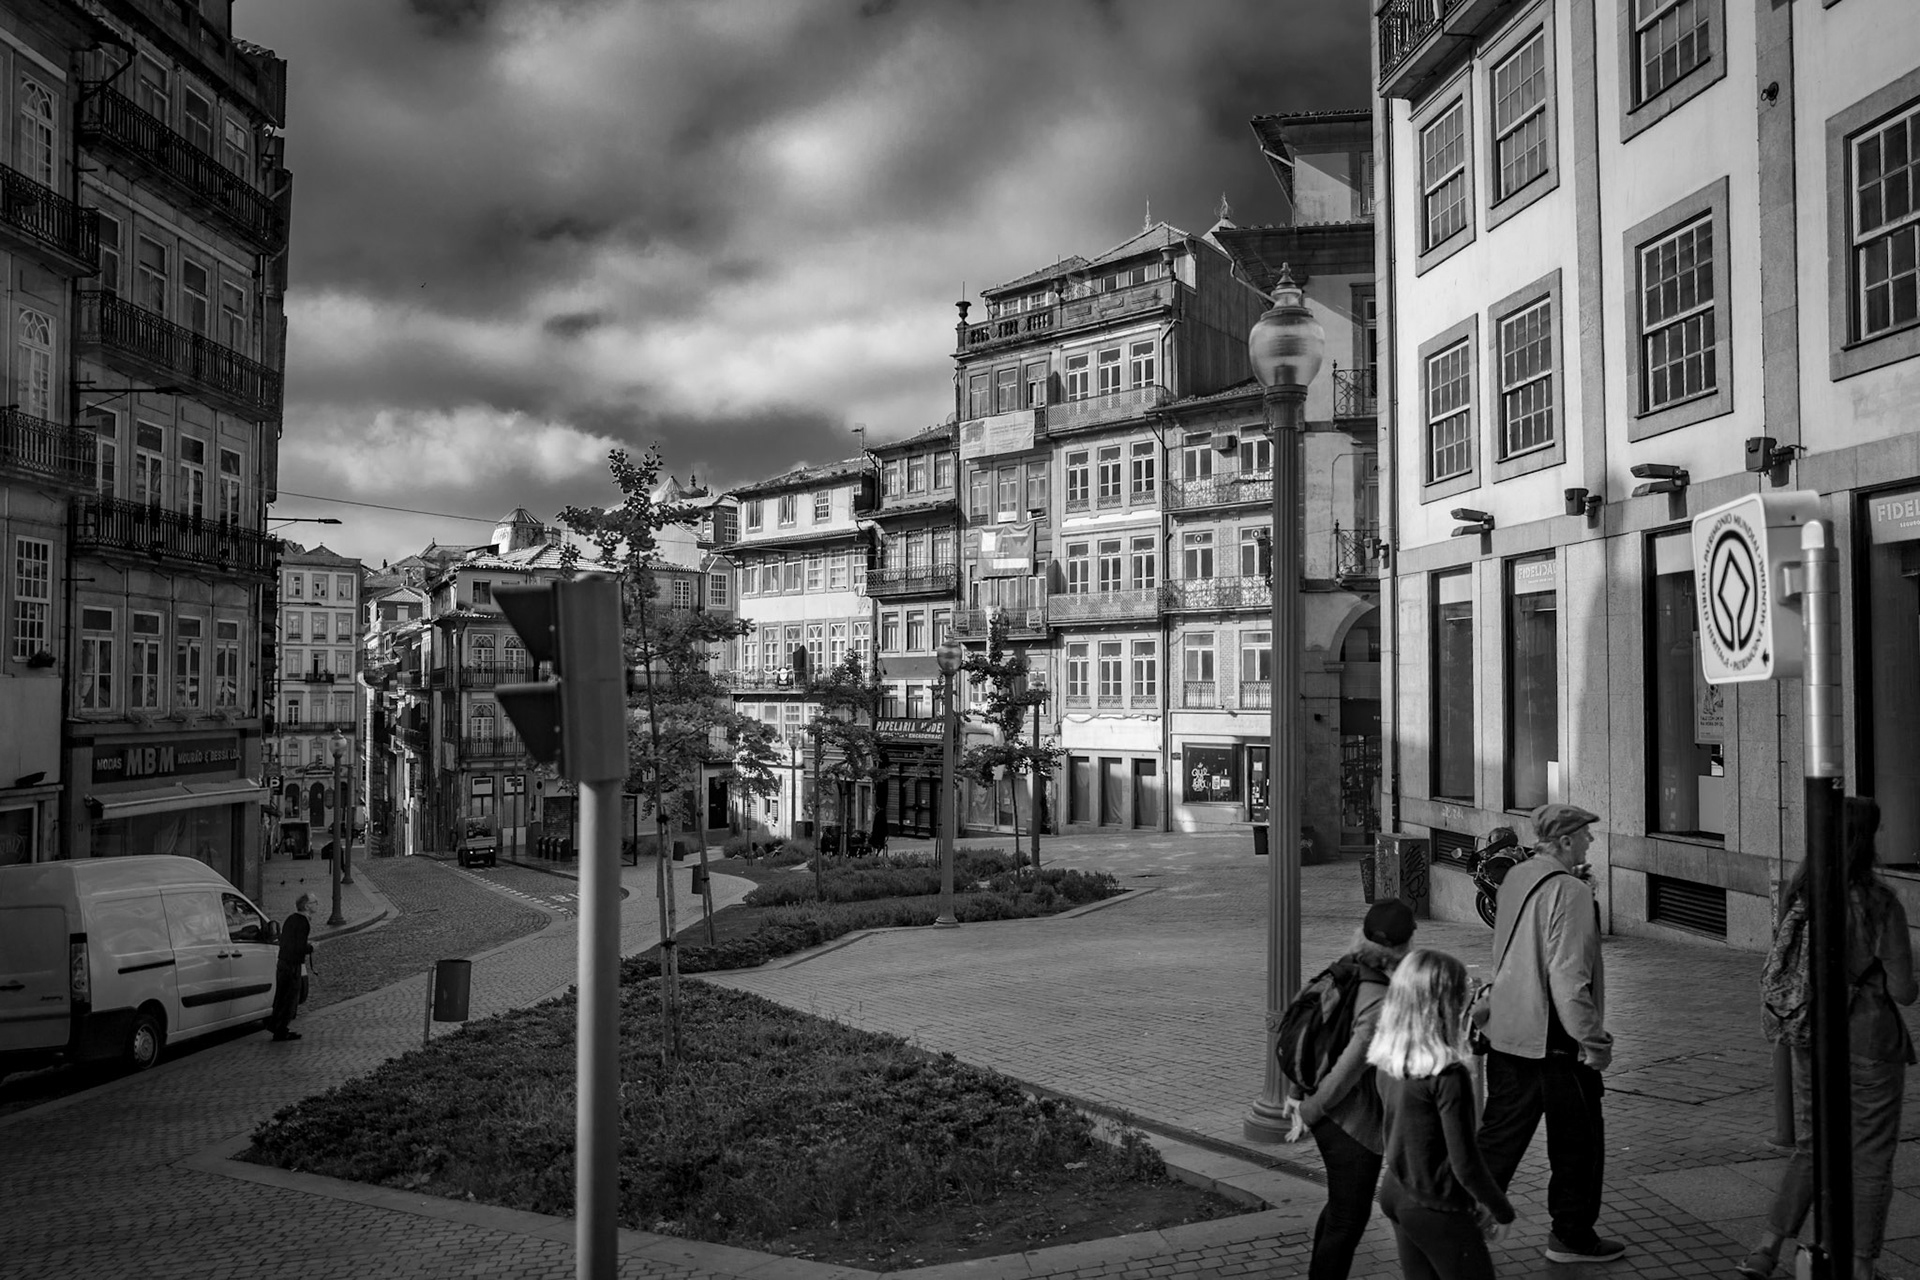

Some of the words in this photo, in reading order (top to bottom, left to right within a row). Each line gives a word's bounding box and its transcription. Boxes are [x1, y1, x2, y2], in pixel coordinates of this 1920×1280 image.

[876, 721, 915, 732] PAPELARIA
[96, 758, 122, 771] MODAS
[126, 746, 175, 776] MBM
